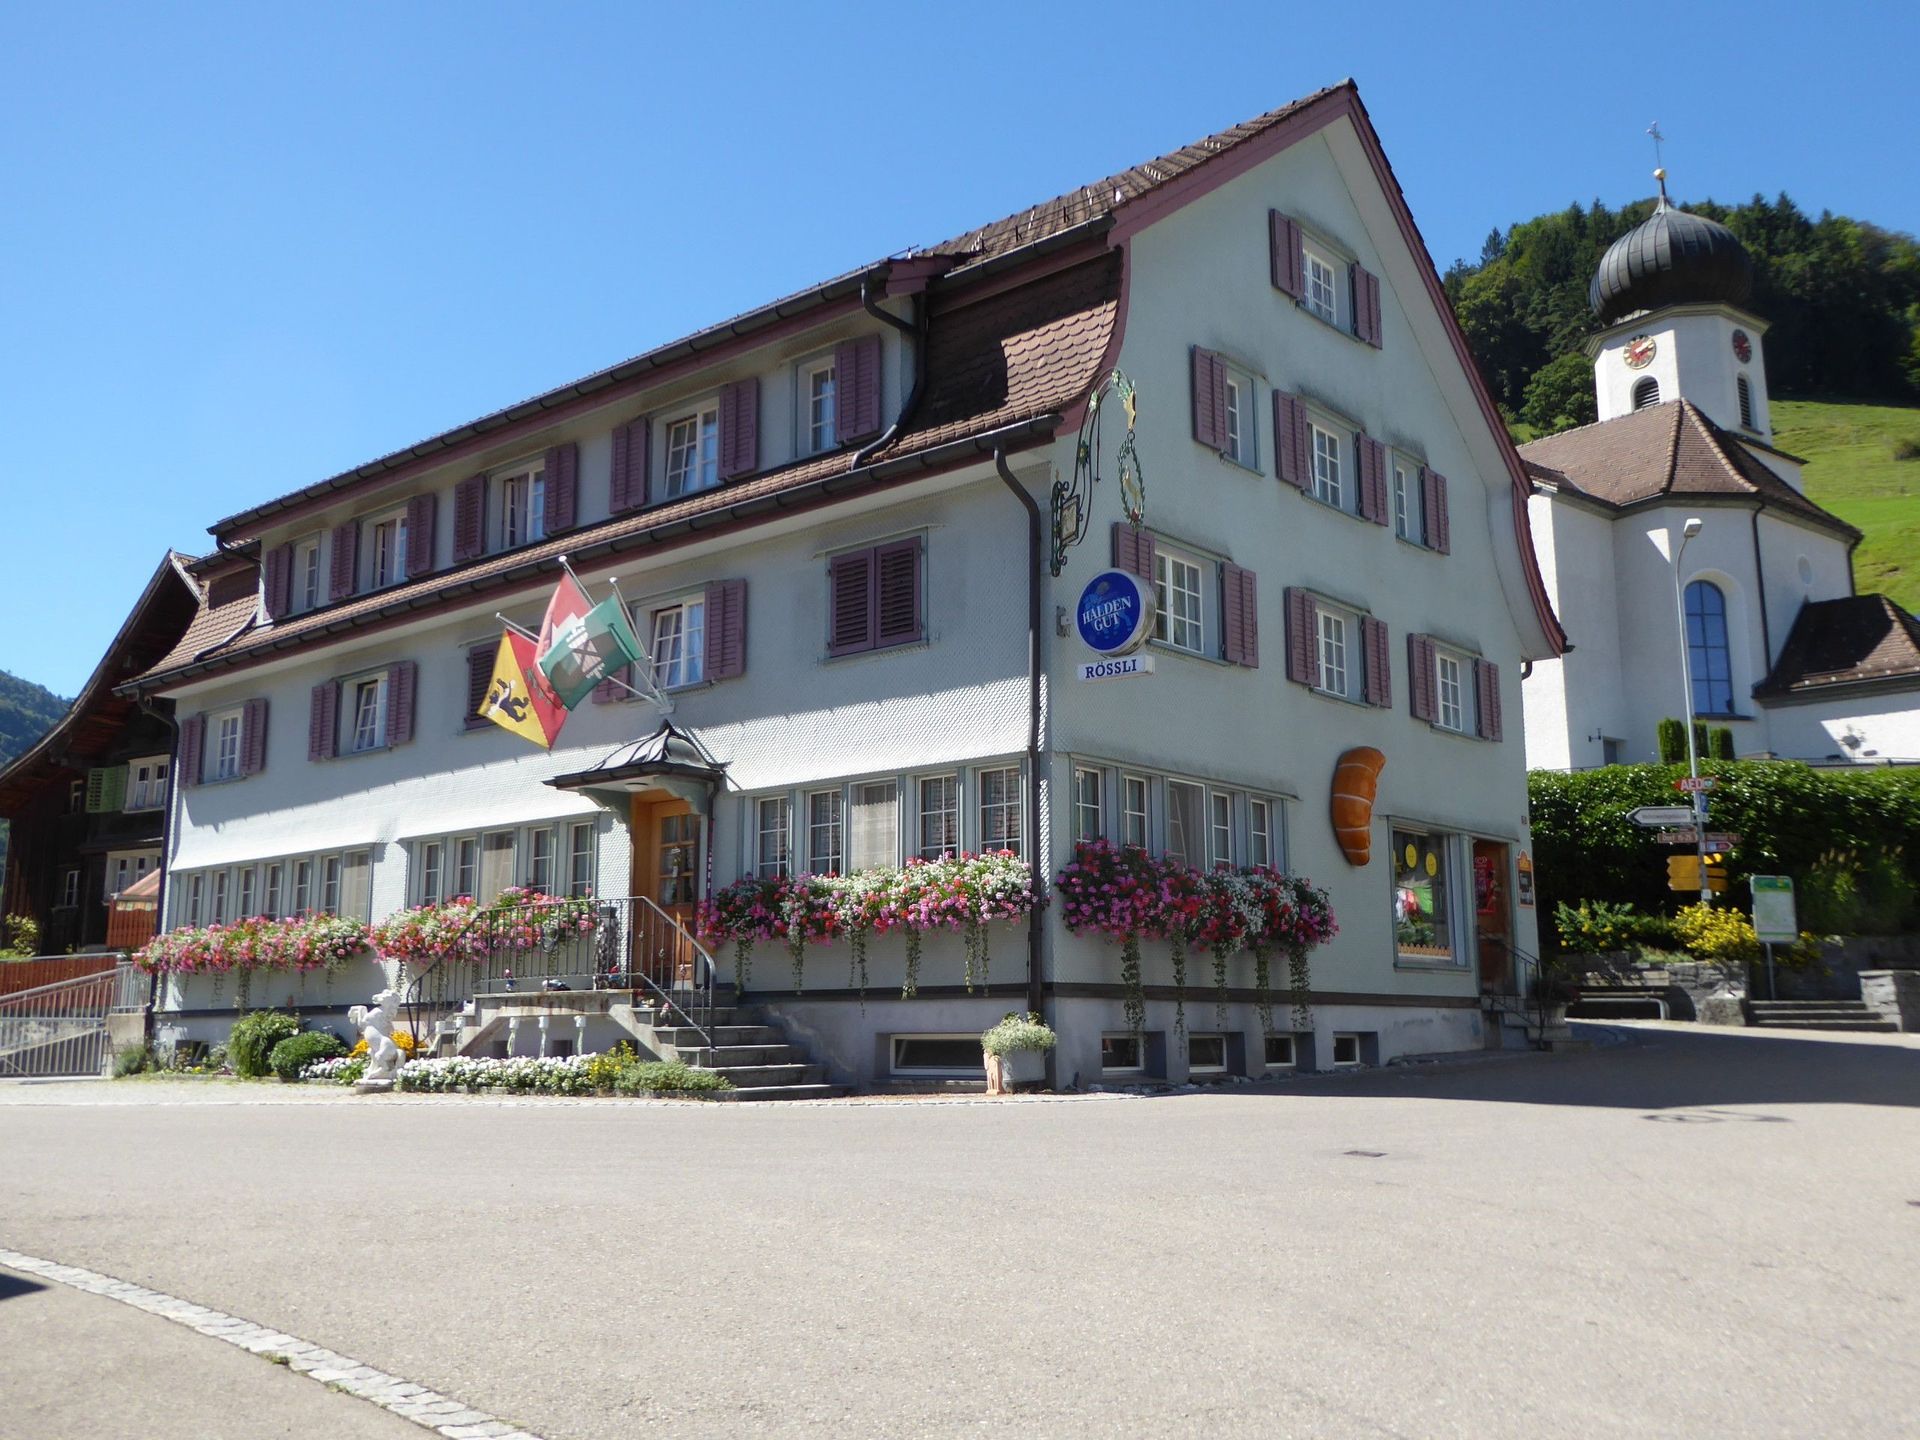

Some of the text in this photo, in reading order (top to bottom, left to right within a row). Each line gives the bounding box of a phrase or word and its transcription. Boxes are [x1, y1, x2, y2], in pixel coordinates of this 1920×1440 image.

[1082, 596, 1132, 624] HALDEN
[1094, 613, 1120, 631] GUT
[1085, 659, 1137, 678] RÖSSLI
[1680, 778, 1702, 791] AED
